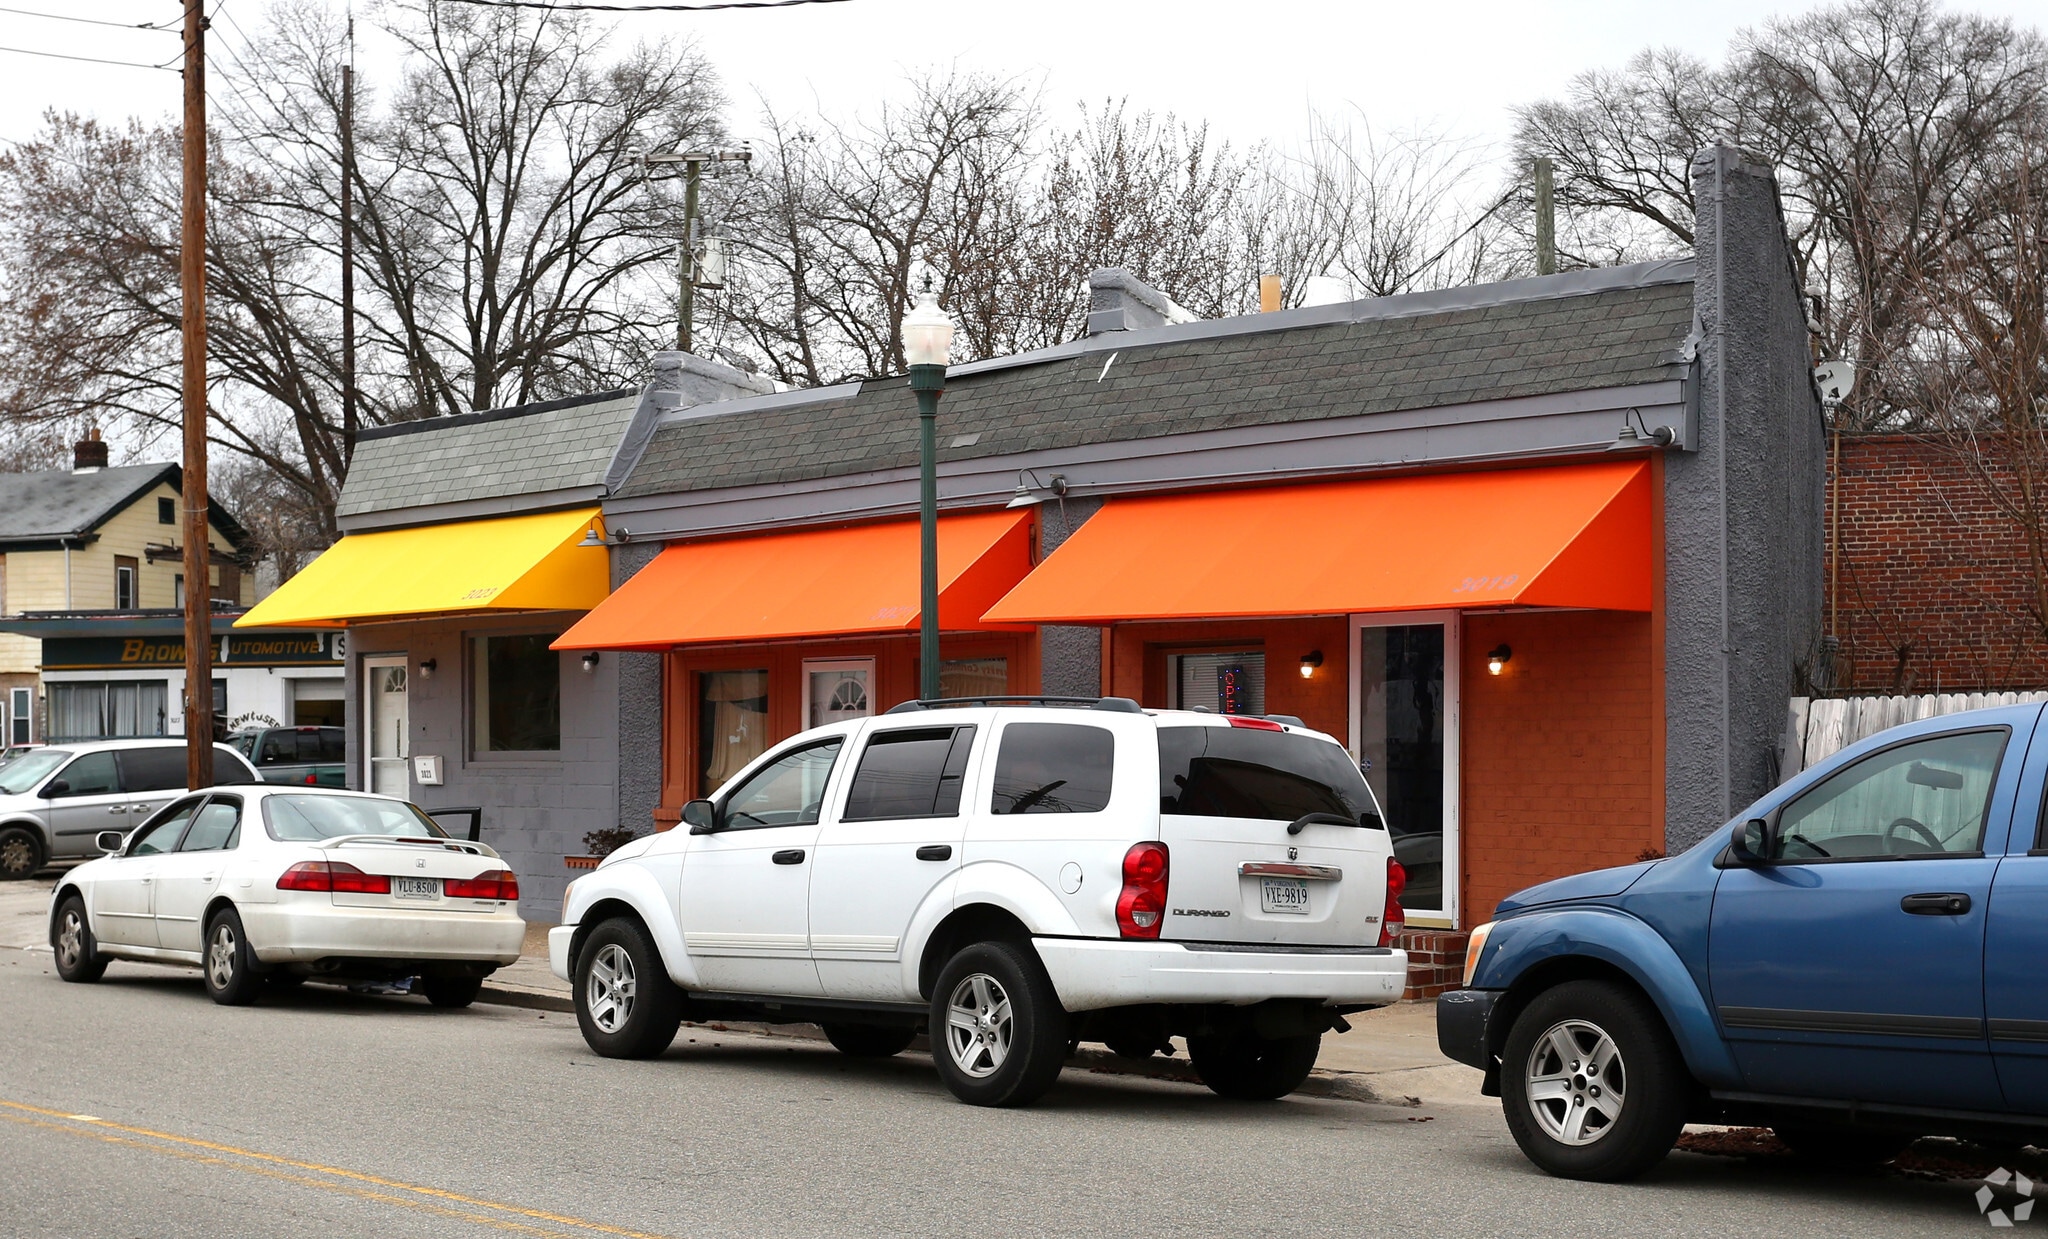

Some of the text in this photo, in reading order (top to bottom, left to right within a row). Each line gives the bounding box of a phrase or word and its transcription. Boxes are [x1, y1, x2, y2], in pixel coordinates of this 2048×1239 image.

[1452, 573, 1519, 592] 3019
[461, 587, 497, 600] 3023
[121, 639, 319, 661] BROWS UTOMOTIVE
[1225, 672, 1235, 713] OPE
[398, 880, 438, 894] VLU-8500
[1265, 887, 1308, 904] VXE-9819
[1172, 908, 1231, 918] DURANGO
